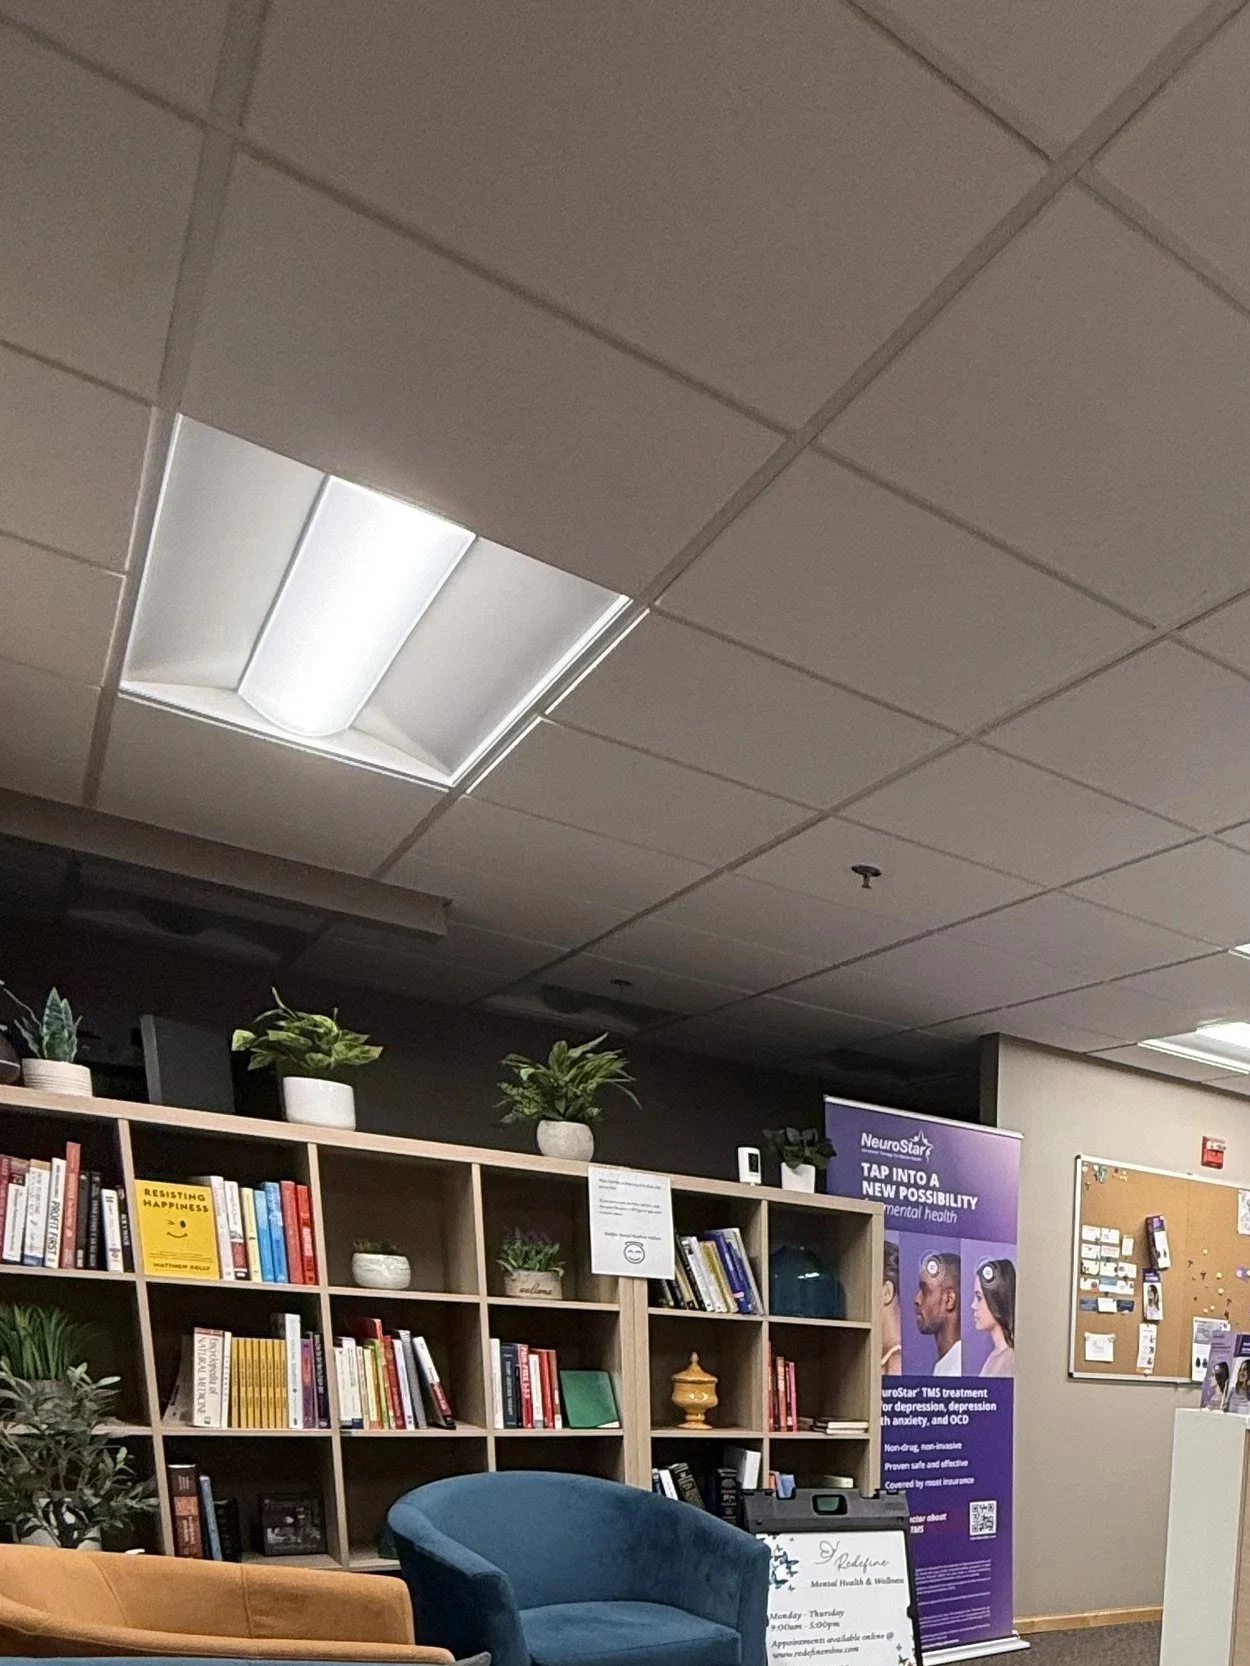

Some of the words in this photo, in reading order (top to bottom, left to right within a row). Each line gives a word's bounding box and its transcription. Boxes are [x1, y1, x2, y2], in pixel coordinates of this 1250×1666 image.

[861, 1132, 925, 1156] NeuroStar
[861, 1162, 889, 1180] TAP
[892, 1167, 927, 1186] INTO
[929, 1173, 940, 1188] A
[144, 1188, 206, 1202] RESISTING
[862, 1180, 896, 1199] NEW
[899, 1185, 978, 1211] POSSIBILITY
[143, 1199, 209, 1213] HAPPINESS
[884, 1201, 922, 1220] mental
[924, 1205, 958, 1224] health
[50, 1200, 60, 1231] PROFIT
[47, 1232, 58, 1256] FIRST
[519, 1283, 553, 1296] welcome
[922, 1387, 941, 1398] TMS
[942, 1388, 988, 1398] treatment
[894, 1401, 947, 1414] depression,
[948, 1402, 997, 1413] depression
[892, 1416, 930, 1428] anxiety,
[932, 1414, 948, 1425] and
[950, 1415, 969, 1425] OCD
[920, 1442, 962, 1450] non-invasive
[884, 1462, 910, 1470] Proven
[911, 1460, 925, 1469] safe
[926, 1460, 940, 1468] and
[940, 1459, 968, 1468] effective
[885, 1480, 914, 1489] Covered
[916, 1480, 924, 1489] by
[925, 1479, 942, 1487] most
[943, 1476, 974, 1486] insurance
[927, 1512, 948, 1522] about
[834, 1553, 890, 1574] Redefine
[811, 1578, 838, 1588] Mental
[839, 1578, 864, 1588] Health
[865, 1578, 872, 1586] &
[874, 1576, 904, 1586] Wellness
[770, 1611, 802, 1621] Monday
[808, 1608, 845, 1618] Thursday
[770, 1623, 802, 1632] 9:00am
[808, 1621, 840, 1630] 5:00pm
[771, 1638, 826, 1649] Appointments
[826, 1634, 861, 1644] available
[862, 1632, 885, 1640] online
[886, 1632, 895, 1640] @
